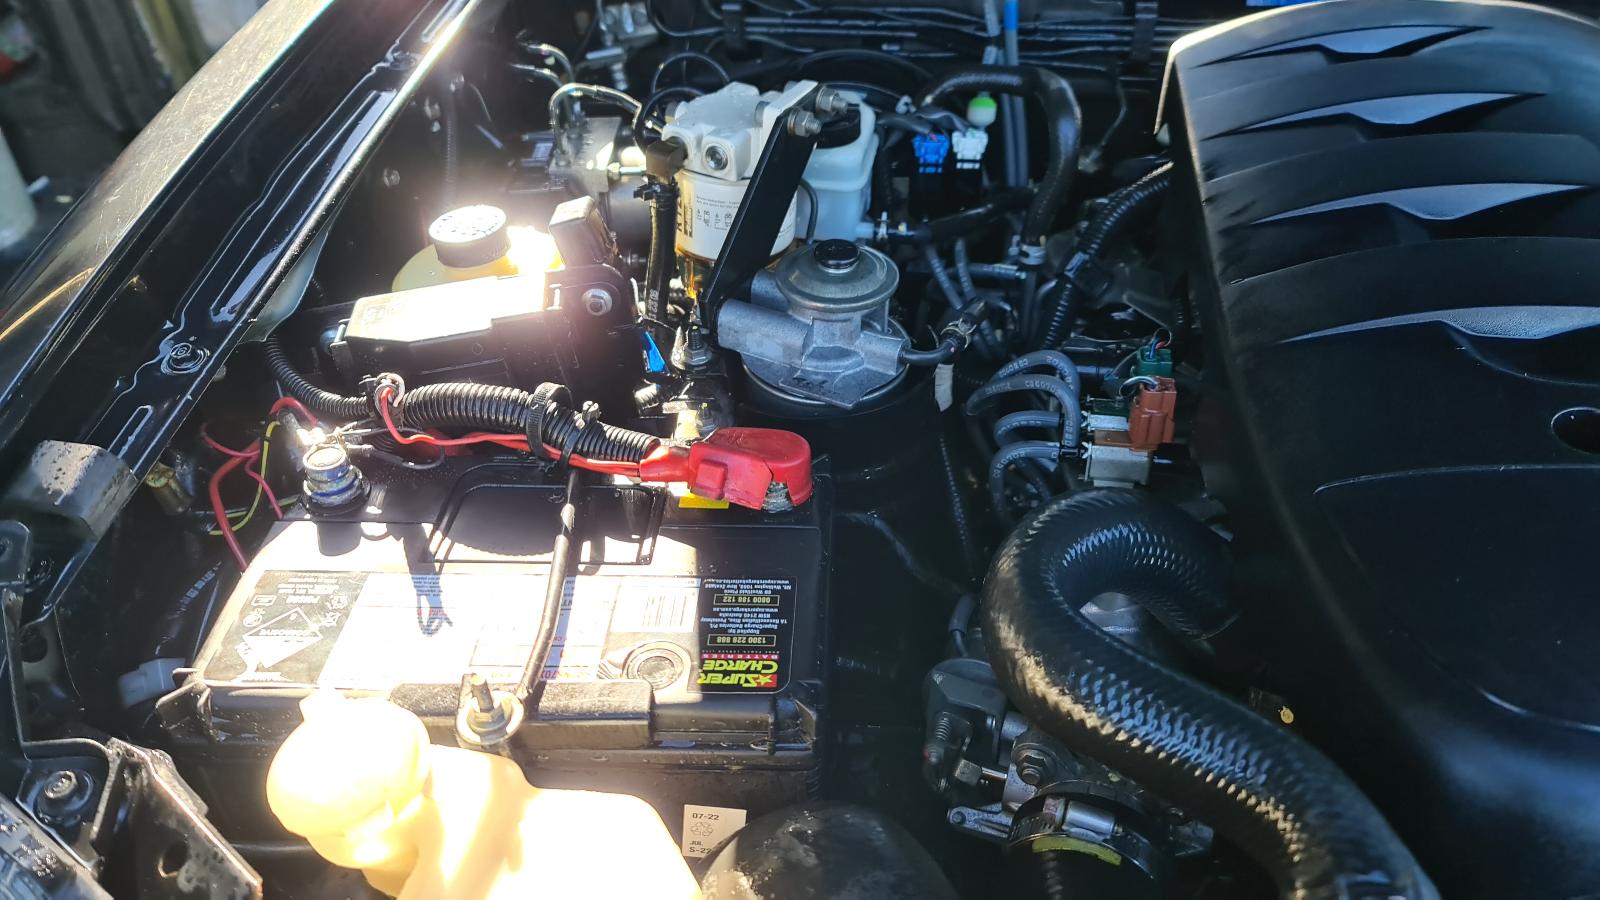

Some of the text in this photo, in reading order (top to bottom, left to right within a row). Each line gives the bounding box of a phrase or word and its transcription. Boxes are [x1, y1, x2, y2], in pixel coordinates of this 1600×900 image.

[702, 660, 778, 673] CHARGE
[696, 673, 758, 687] SUPER
[692, 812, 720, 820] 07-22
